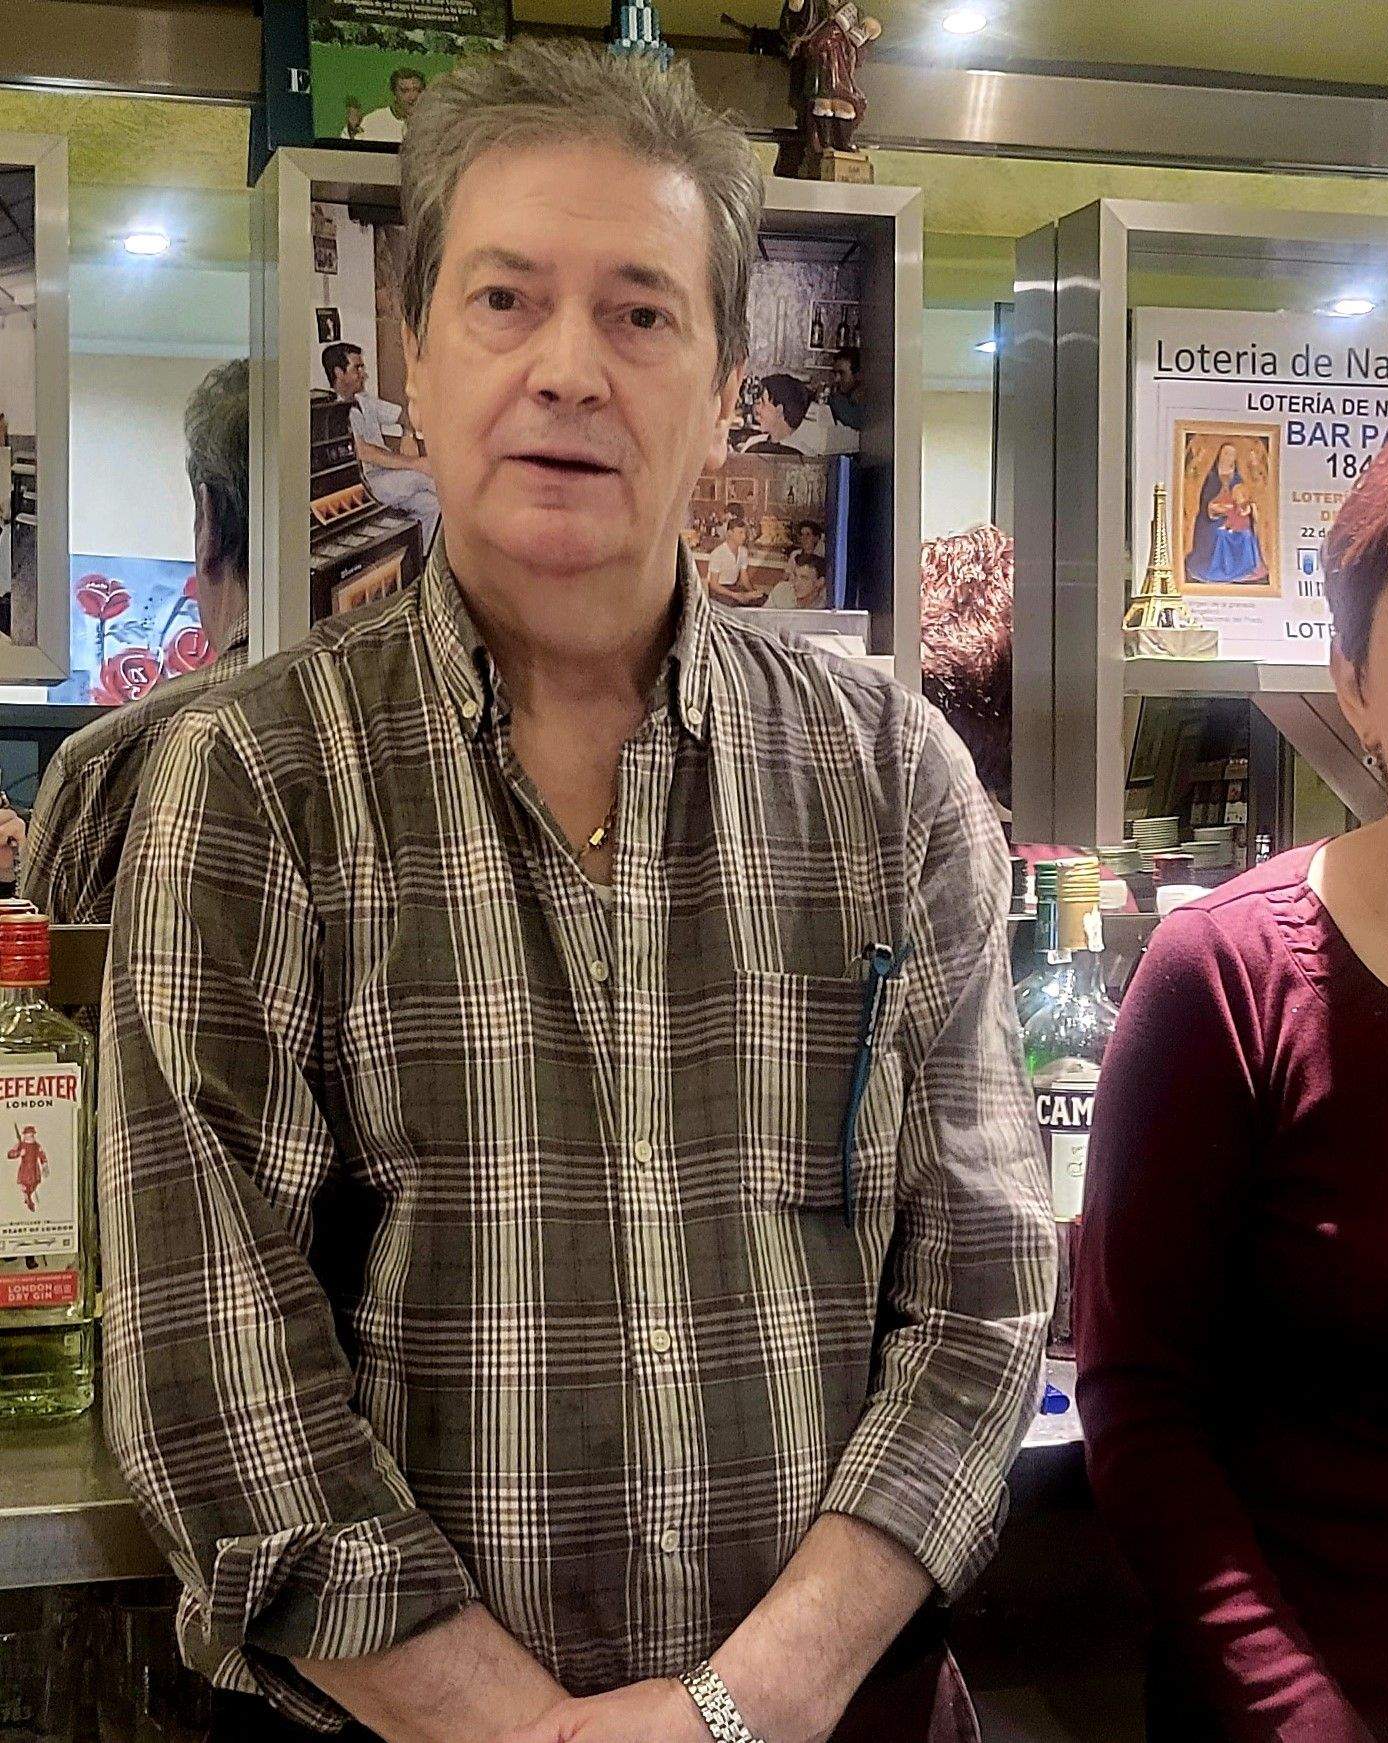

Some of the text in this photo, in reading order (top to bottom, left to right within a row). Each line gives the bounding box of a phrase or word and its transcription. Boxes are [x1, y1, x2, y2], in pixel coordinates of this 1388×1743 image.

[1157, 340, 1278, 376] Loteria
[1291, 343, 1333, 377] de
[1247, 392, 1335, 415] LOTERÍA
[1342, 399, 1369, 416] DE
[1287, 421, 1350, 448] BAR
[1301, 527, 1314, 537] 22
[7, 1100, 53, 1109] LONDON
[9, 1283, 52, 1293] LONDON
[8, 1291, 52, 1301] DRY GIN
